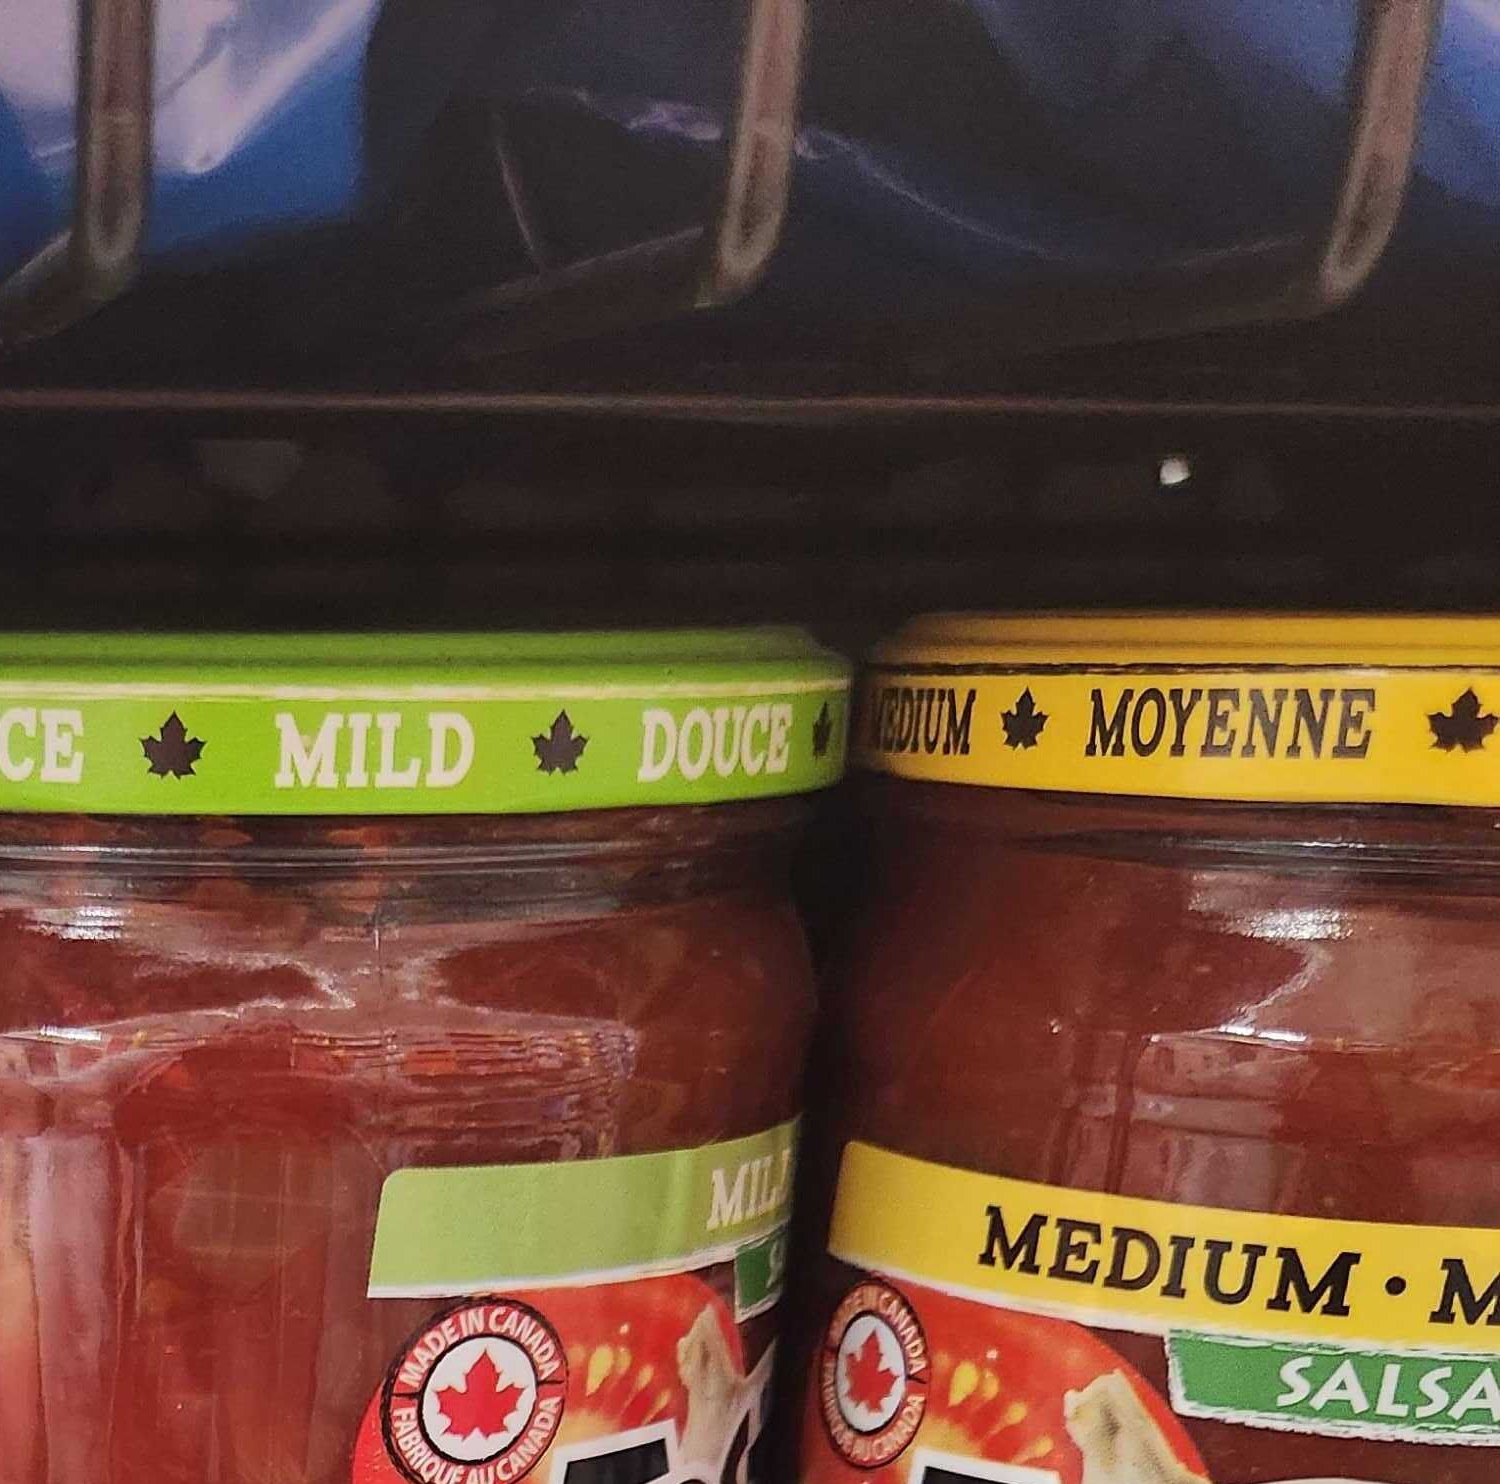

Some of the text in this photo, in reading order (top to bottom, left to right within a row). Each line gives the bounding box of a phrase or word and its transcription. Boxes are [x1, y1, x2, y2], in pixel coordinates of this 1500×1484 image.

[273, 712, 476, 790] MILD
[637, 702, 794, 782] DOUCE
[1084, 687, 1377, 760] MOYENNE
[976, 1204, 1362, 1318] MEDIUM
[399, 1306, 564, 1389] MADE IN CANADA
[1275, 1354, 1500, 1422] SALSA
[495, 1396, 564, 1482] CANADA
